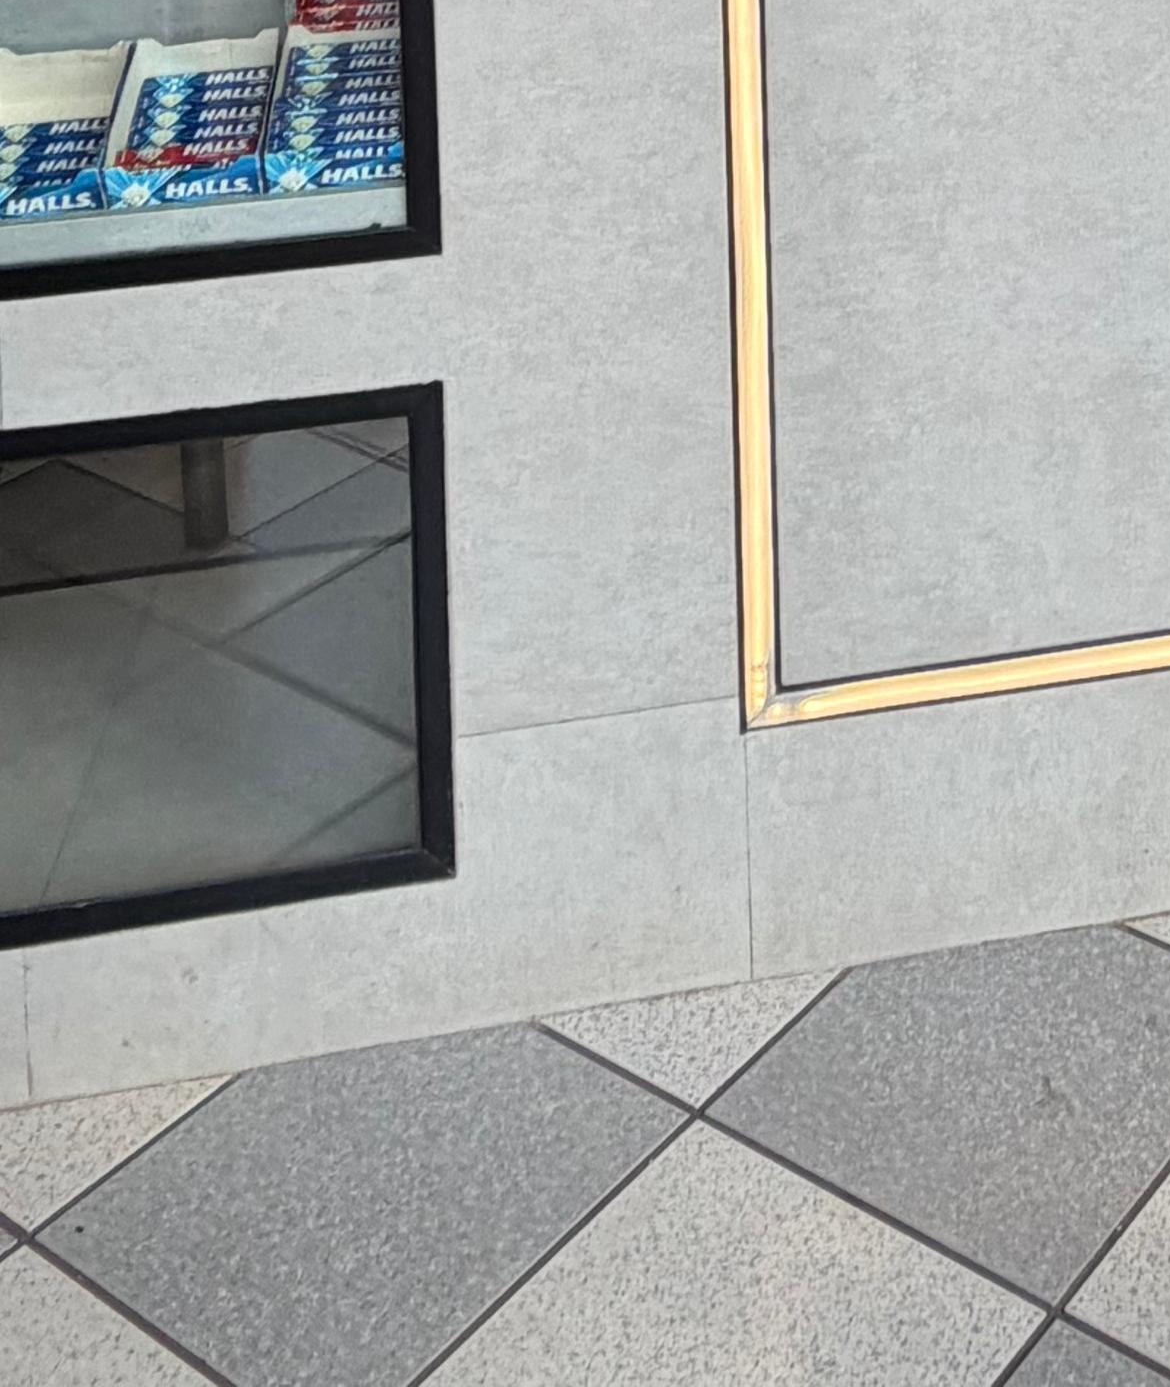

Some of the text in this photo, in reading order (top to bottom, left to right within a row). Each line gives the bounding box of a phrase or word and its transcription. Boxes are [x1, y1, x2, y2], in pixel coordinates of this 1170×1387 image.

[350, 39, 401, 55] HALL
[349, 54, 400, 70] HALL
[205, 68, 270, 86] HALLS
[202, 84, 267, 103] HALLS
[198, 104, 263, 123] HALLS
[335, 108, 400, 126] HALLS
[193, 122, 259, 140] HALLS
[333, 126, 402, 144] HALLS
[182, 138, 250, 157] HALLS
[321, 163, 405, 185] HALLS
[165, 176, 253, 200] HALLS
[5, 191, 97, 216] HALLS
